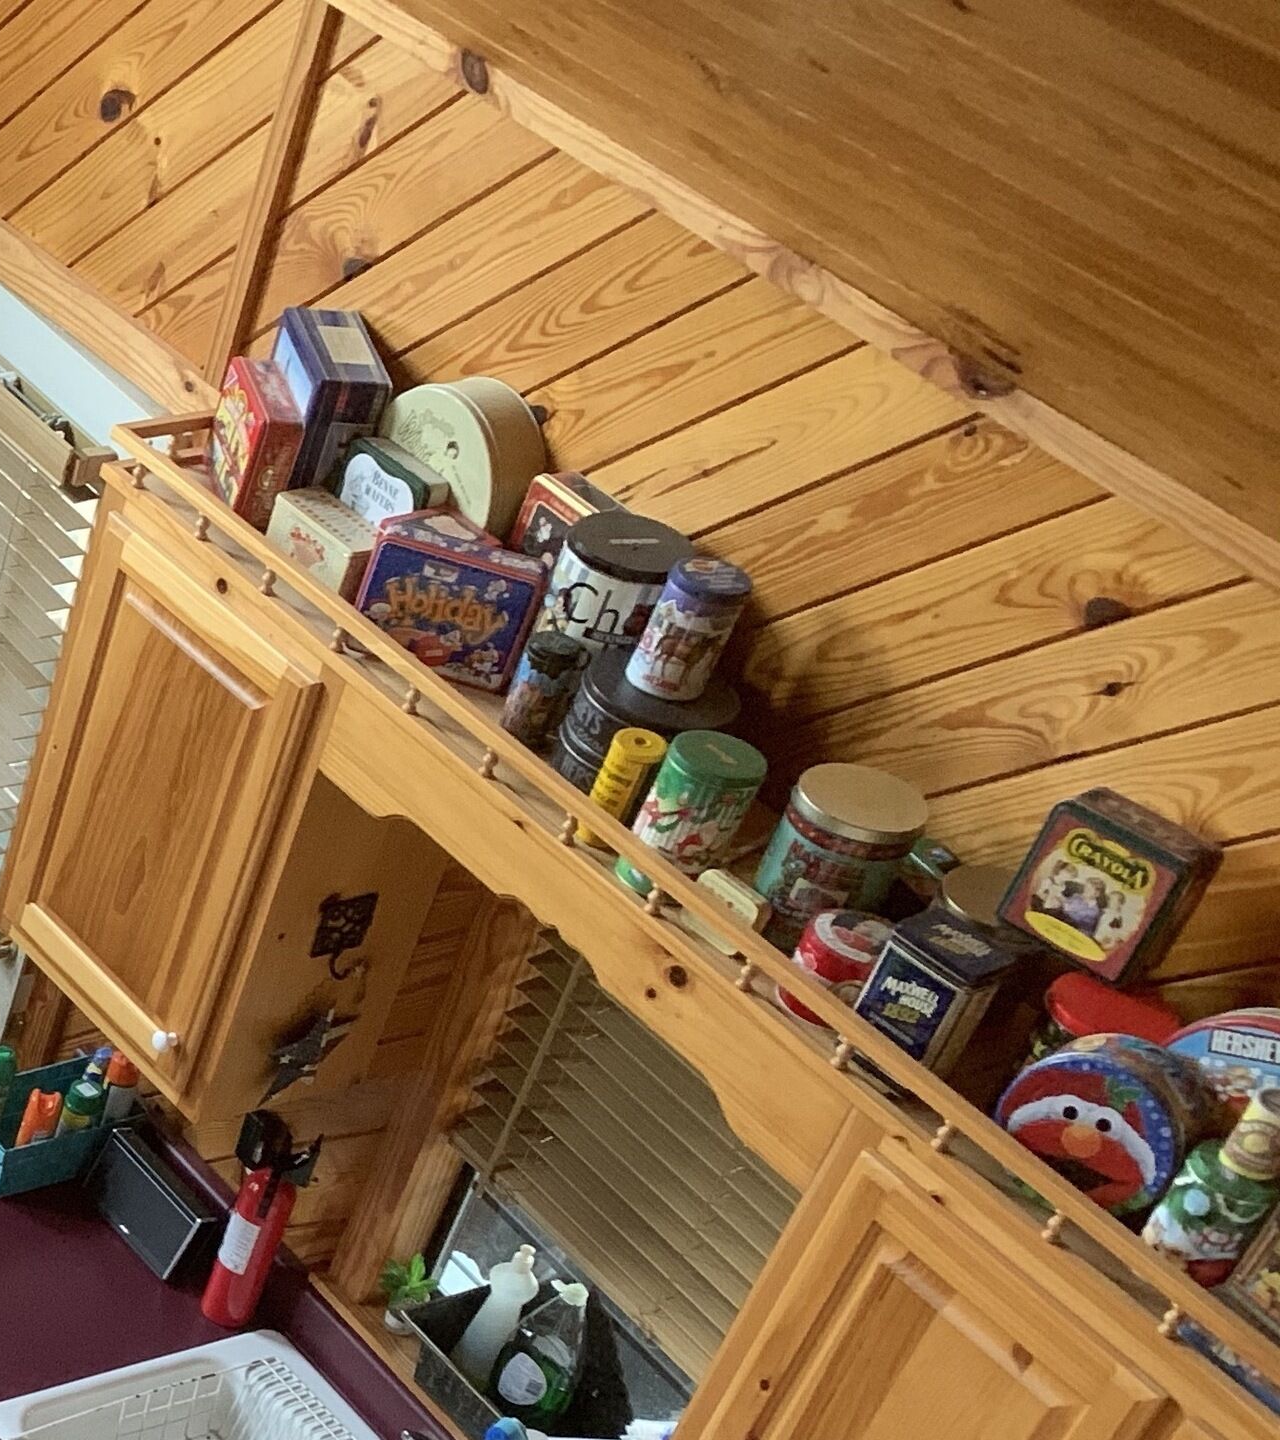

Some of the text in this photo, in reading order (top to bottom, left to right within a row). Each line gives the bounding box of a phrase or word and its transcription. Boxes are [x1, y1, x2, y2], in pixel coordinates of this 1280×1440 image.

[385, 574, 509, 646] Holiday
[1068, 834, 1149, 890] CRAYOLA
[880, 976, 939, 1002] MAXWELL
[1211, 1029, 1280, 1063] HERSHE
